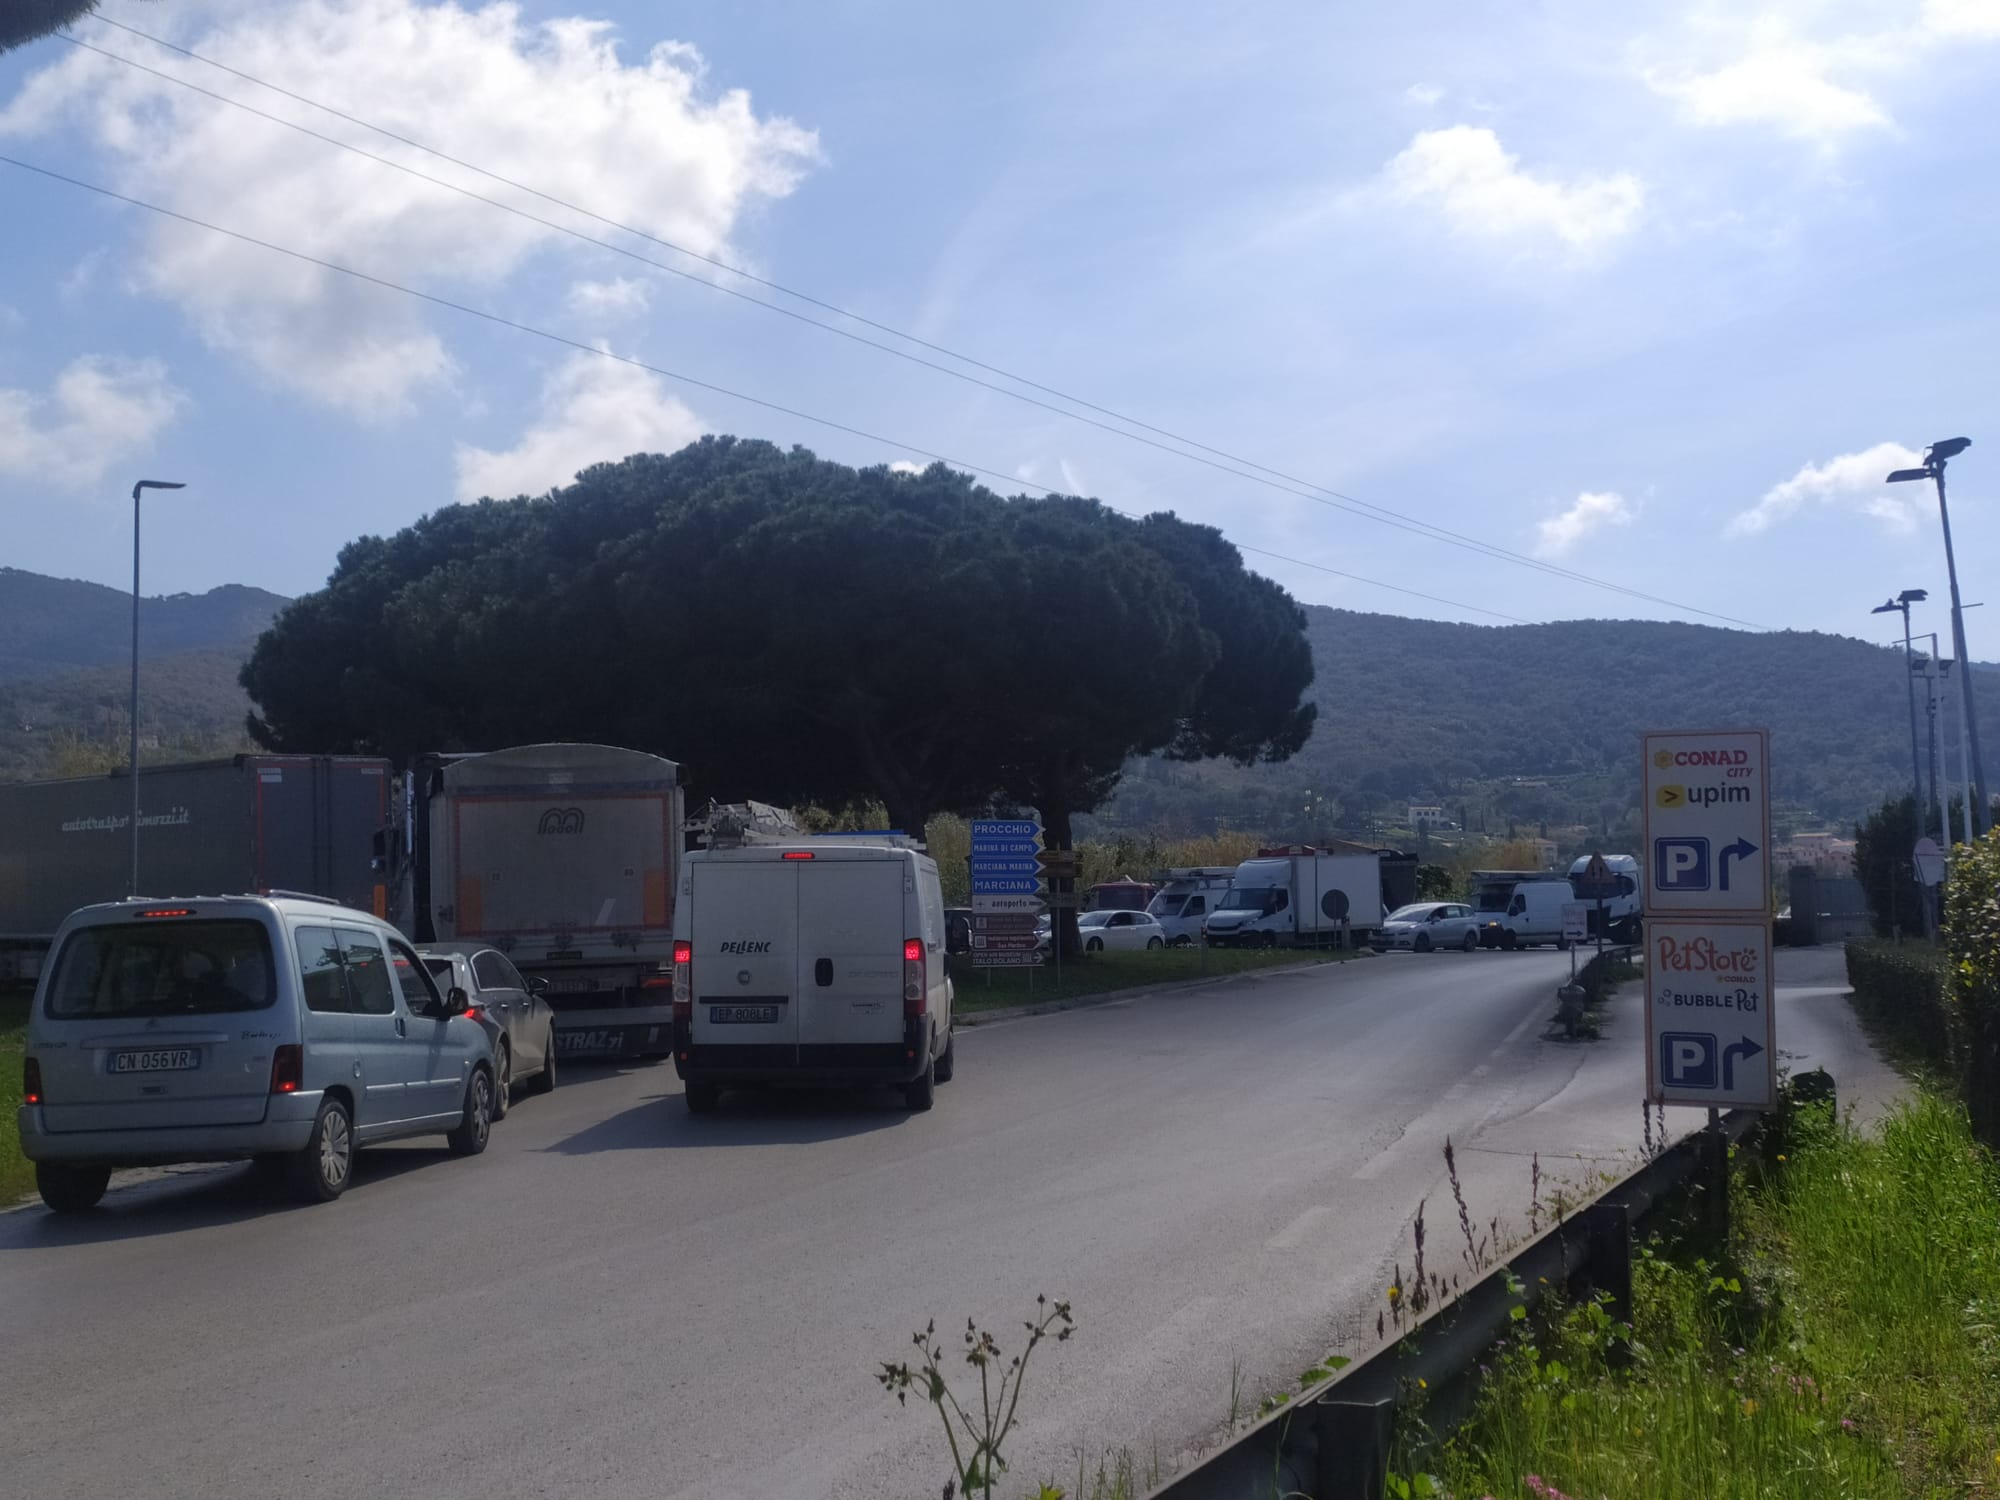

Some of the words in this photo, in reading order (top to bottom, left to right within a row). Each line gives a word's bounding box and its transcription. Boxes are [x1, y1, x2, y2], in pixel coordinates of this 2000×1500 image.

[1674, 750, 1748, 766] CONAD
[1726, 767, 1754, 778] CITY
[1688, 782, 1750, 808] upim
[974, 824, 1031, 834] PROCCHIO
[974, 843, 999, 852] MARINA
[1001, 843, 1008, 852] DI
[1010, 843, 1033, 852] CAMPO
[974, 862, 1007, 871] MARCIANA
[1009, 862, 1033, 871] MARINA
[1666, 846, 1698, 883] P
[974, 880, 1031, 890] MARCIANA
[991, 898, 1028, 909] aeroporto
[720, 940, 771, 954] PELLENC
[1657, 936, 1756, 972] PetStore
[1724, 975, 1756, 984] CONAD
[1674, 994, 1734, 1008] BUBBLE
[1735, 988, 1760, 1013] Pet
[718, 1008, 733, 1020] EP
[117, 1054, 136, 1070] CN
[141, 1051, 189, 1069] 056VR
[1672, 1040, 1706, 1080] P
